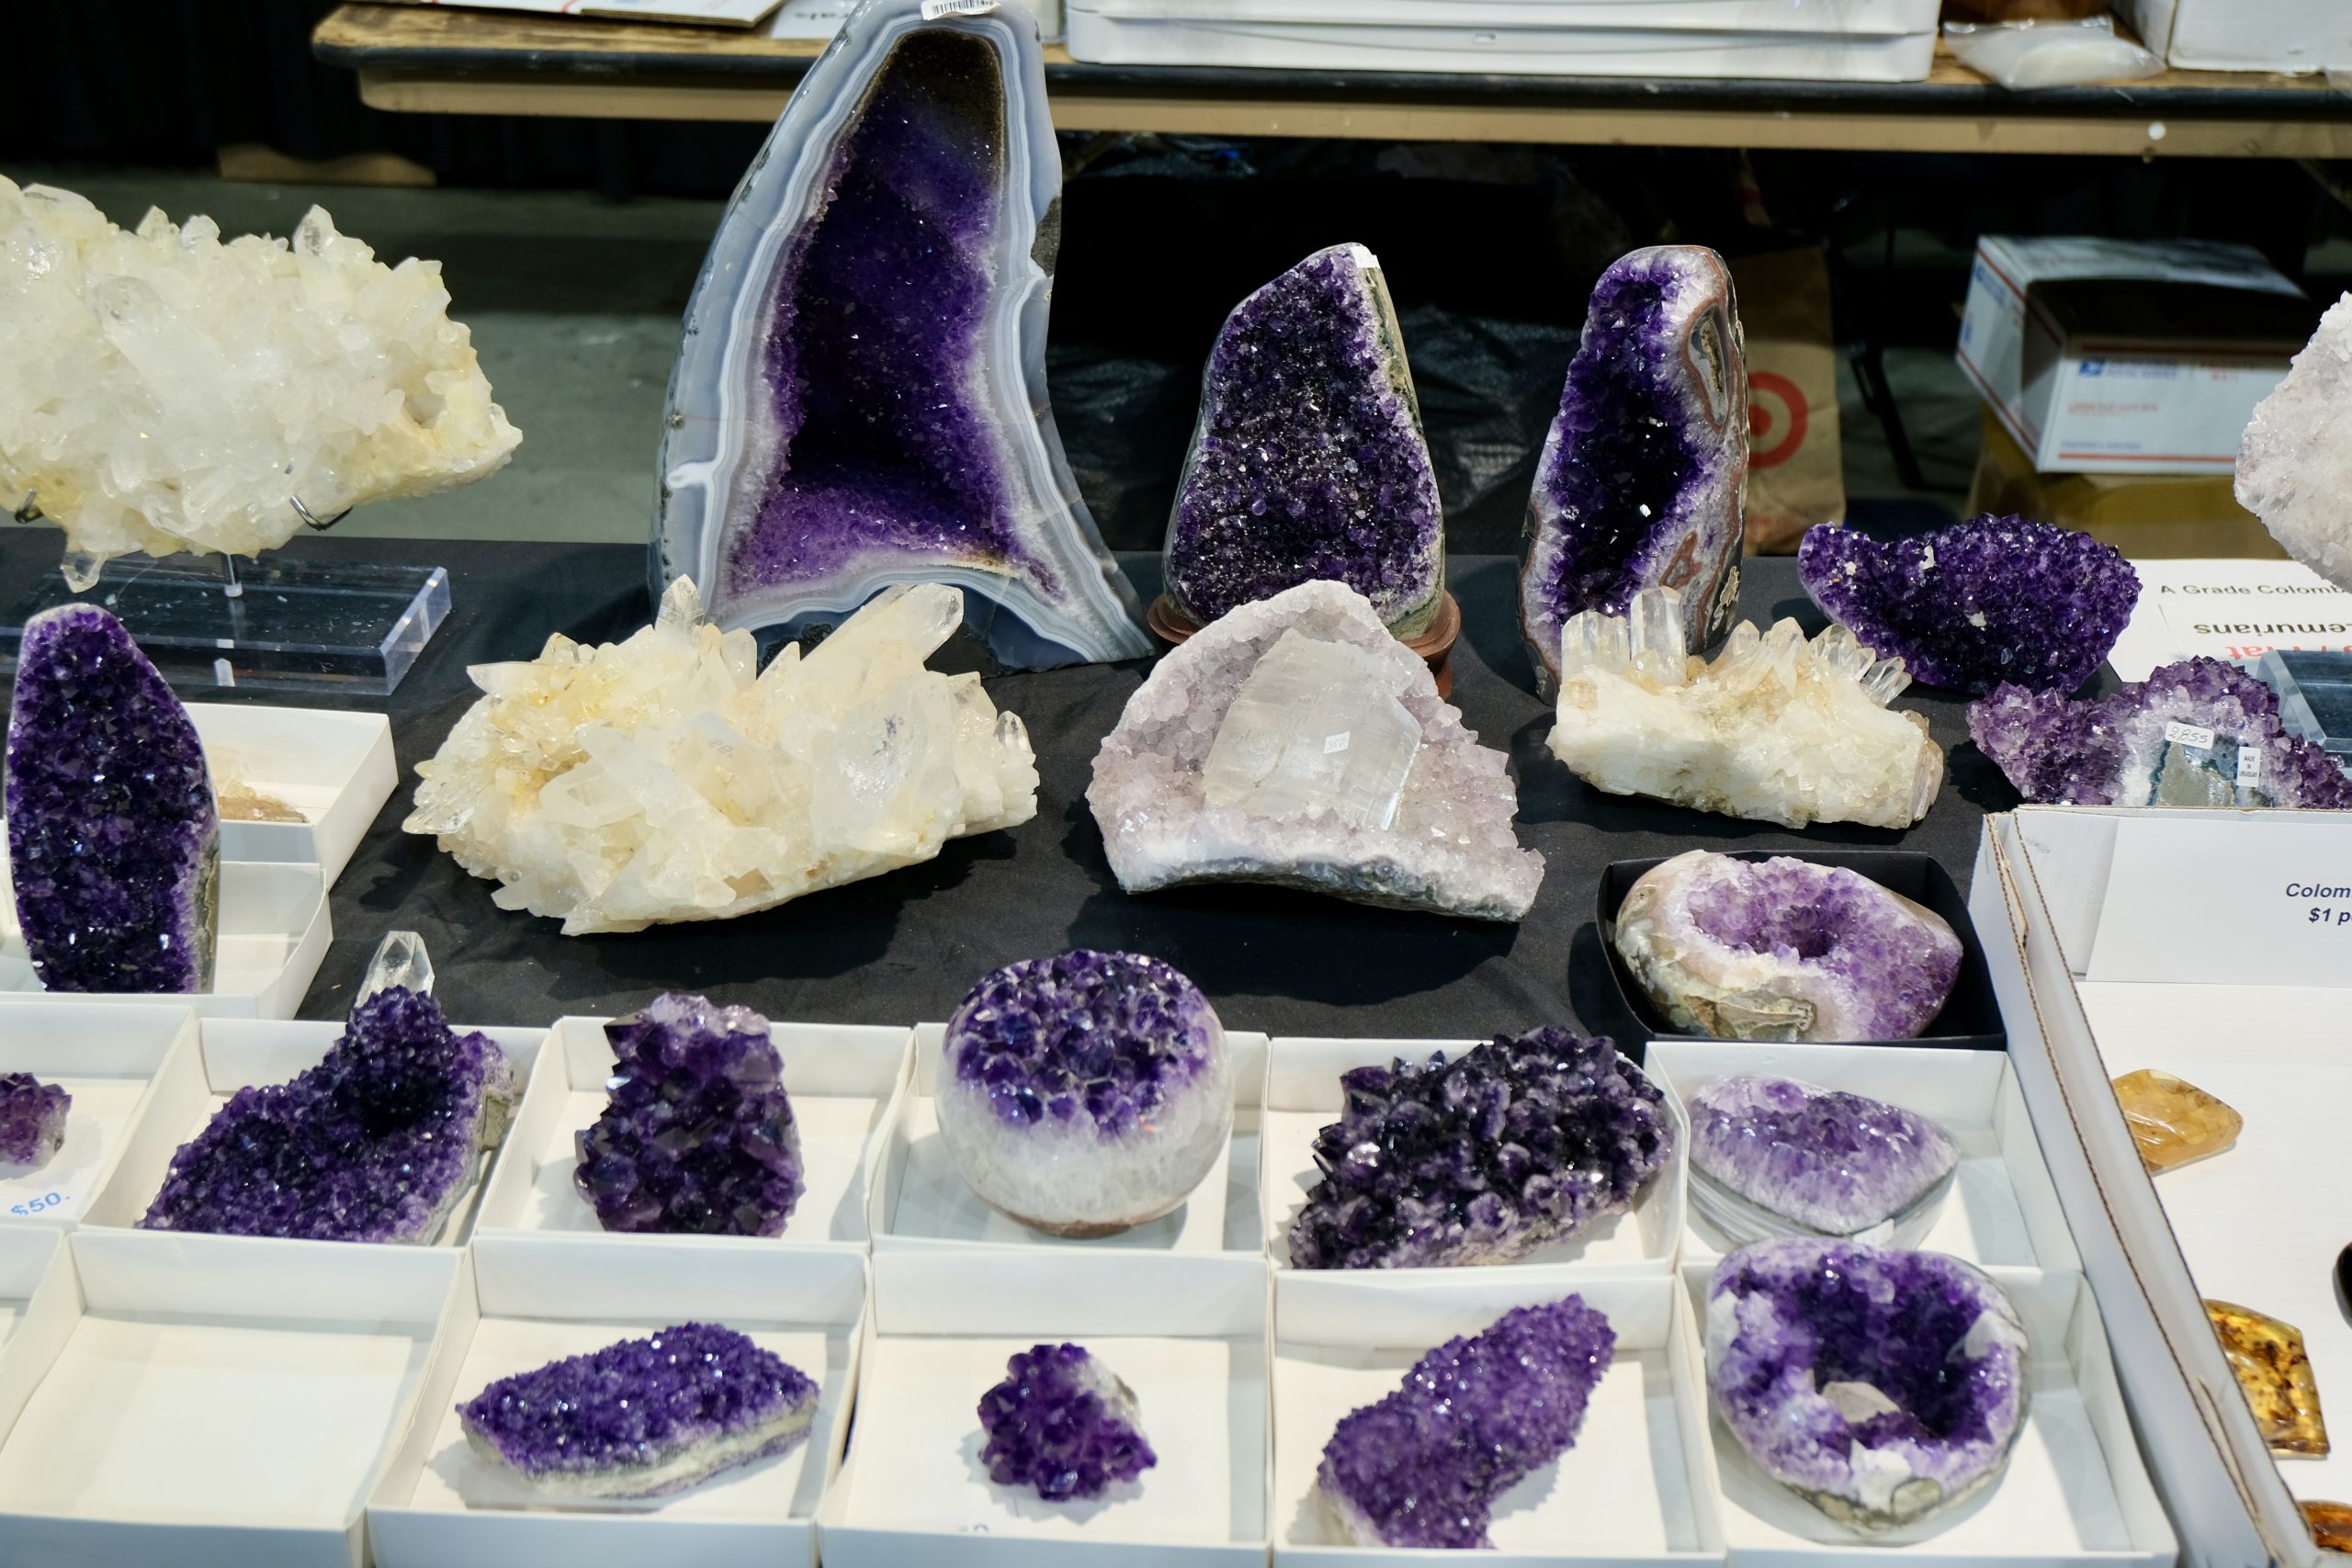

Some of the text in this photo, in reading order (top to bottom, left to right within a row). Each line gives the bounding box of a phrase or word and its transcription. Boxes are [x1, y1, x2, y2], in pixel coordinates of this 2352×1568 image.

[2160, 585, 2176, 594] A
[2182, 584, 2251, 594] Grade
[2308, 907, 2332, 923] $1
